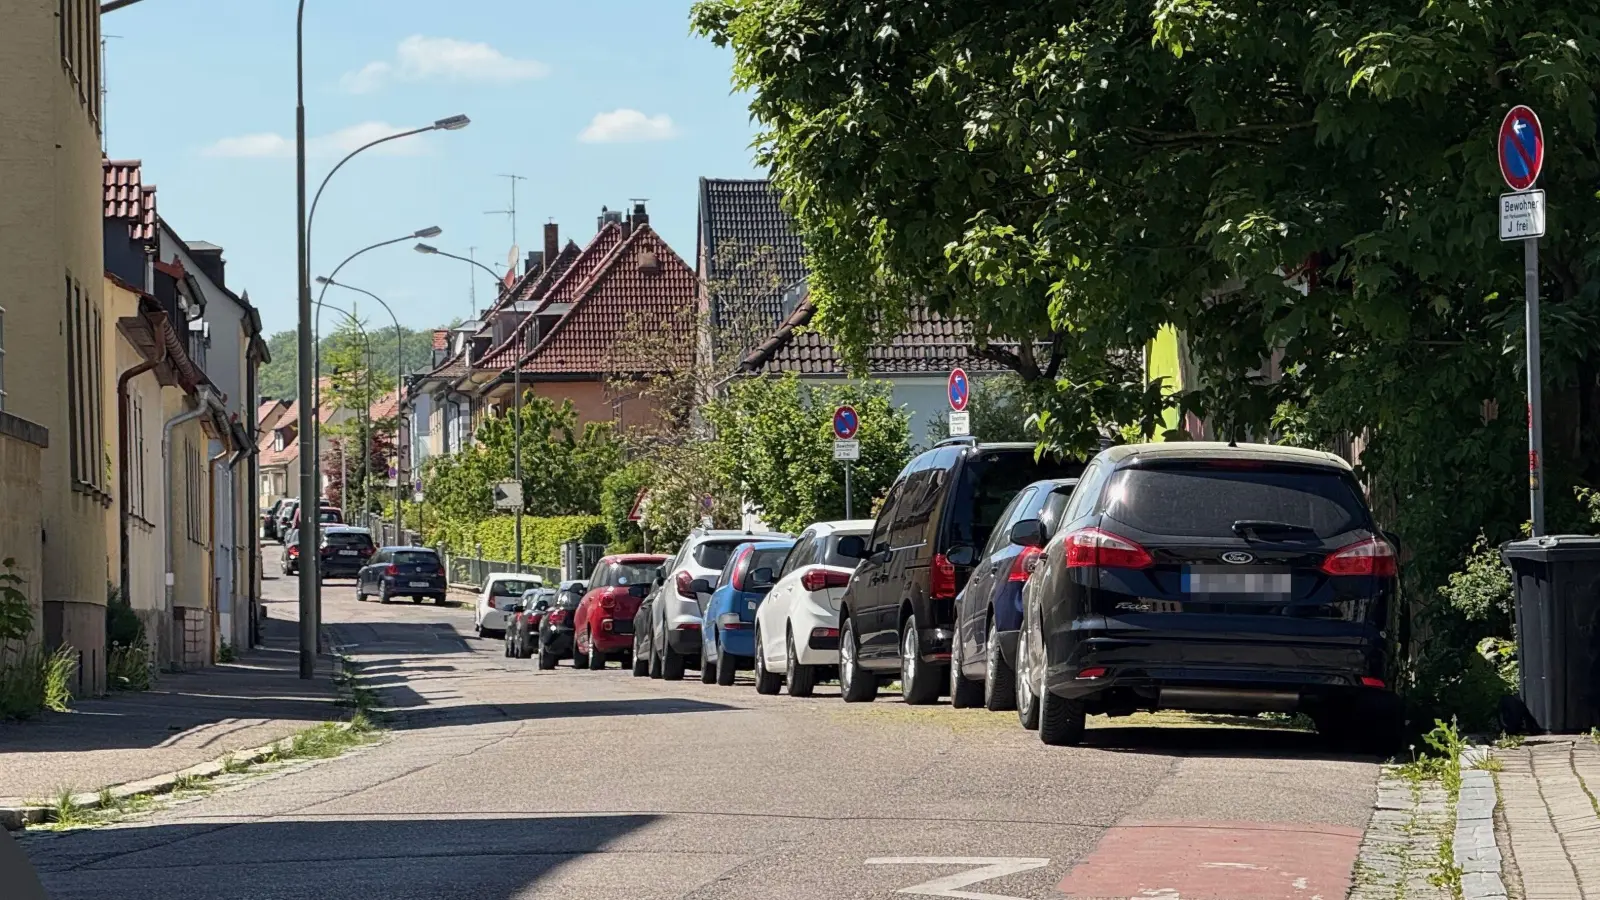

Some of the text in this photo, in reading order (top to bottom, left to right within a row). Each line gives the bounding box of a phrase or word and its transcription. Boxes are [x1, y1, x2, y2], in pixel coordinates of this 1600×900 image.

[1504, 200, 1539, 212] Bewohner
[1508, 219, 1529, 232] J frei
